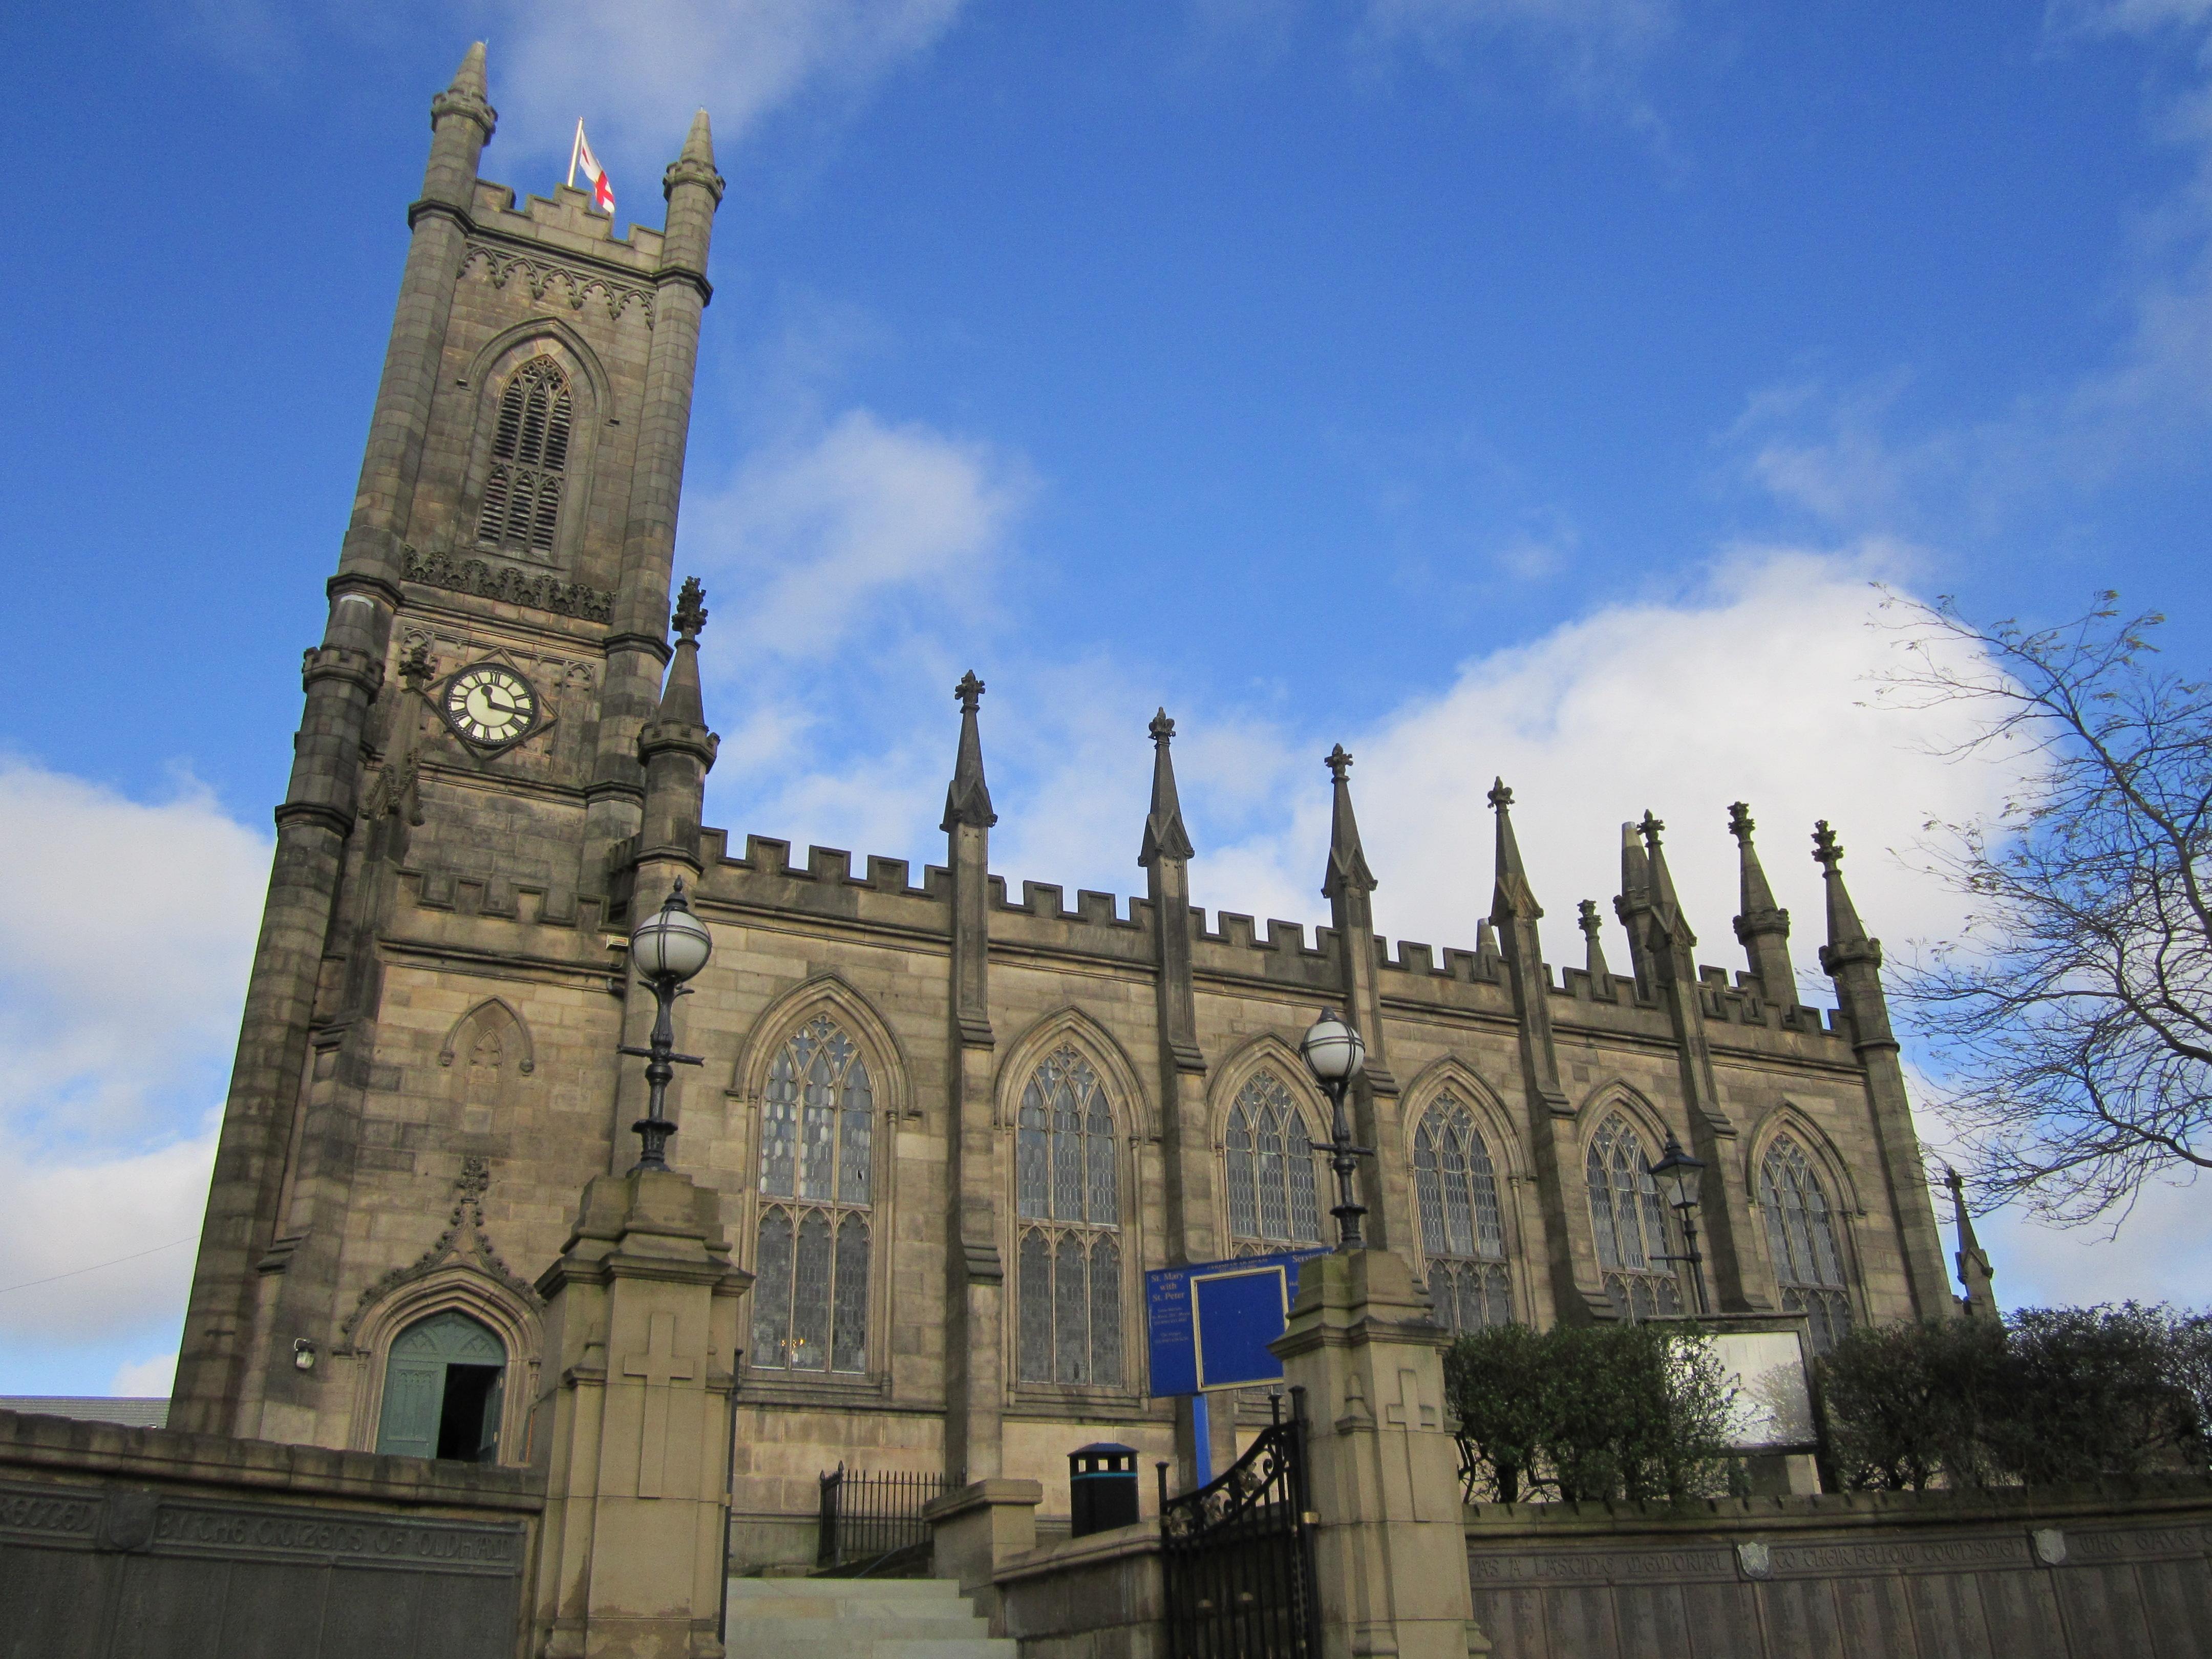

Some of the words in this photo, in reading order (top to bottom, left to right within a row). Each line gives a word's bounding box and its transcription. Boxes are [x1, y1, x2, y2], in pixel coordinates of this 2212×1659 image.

[1151, 1274, 1161, 1283] St.
[1164, 1272, 1184, 1282] Mary
[1159, 1282, 1177, 1291] with
[1164, 1292, 1185, 1300] Peter
[159, 1511, 190, 1538] BY
[374, 1529, 407, 1555] OF
